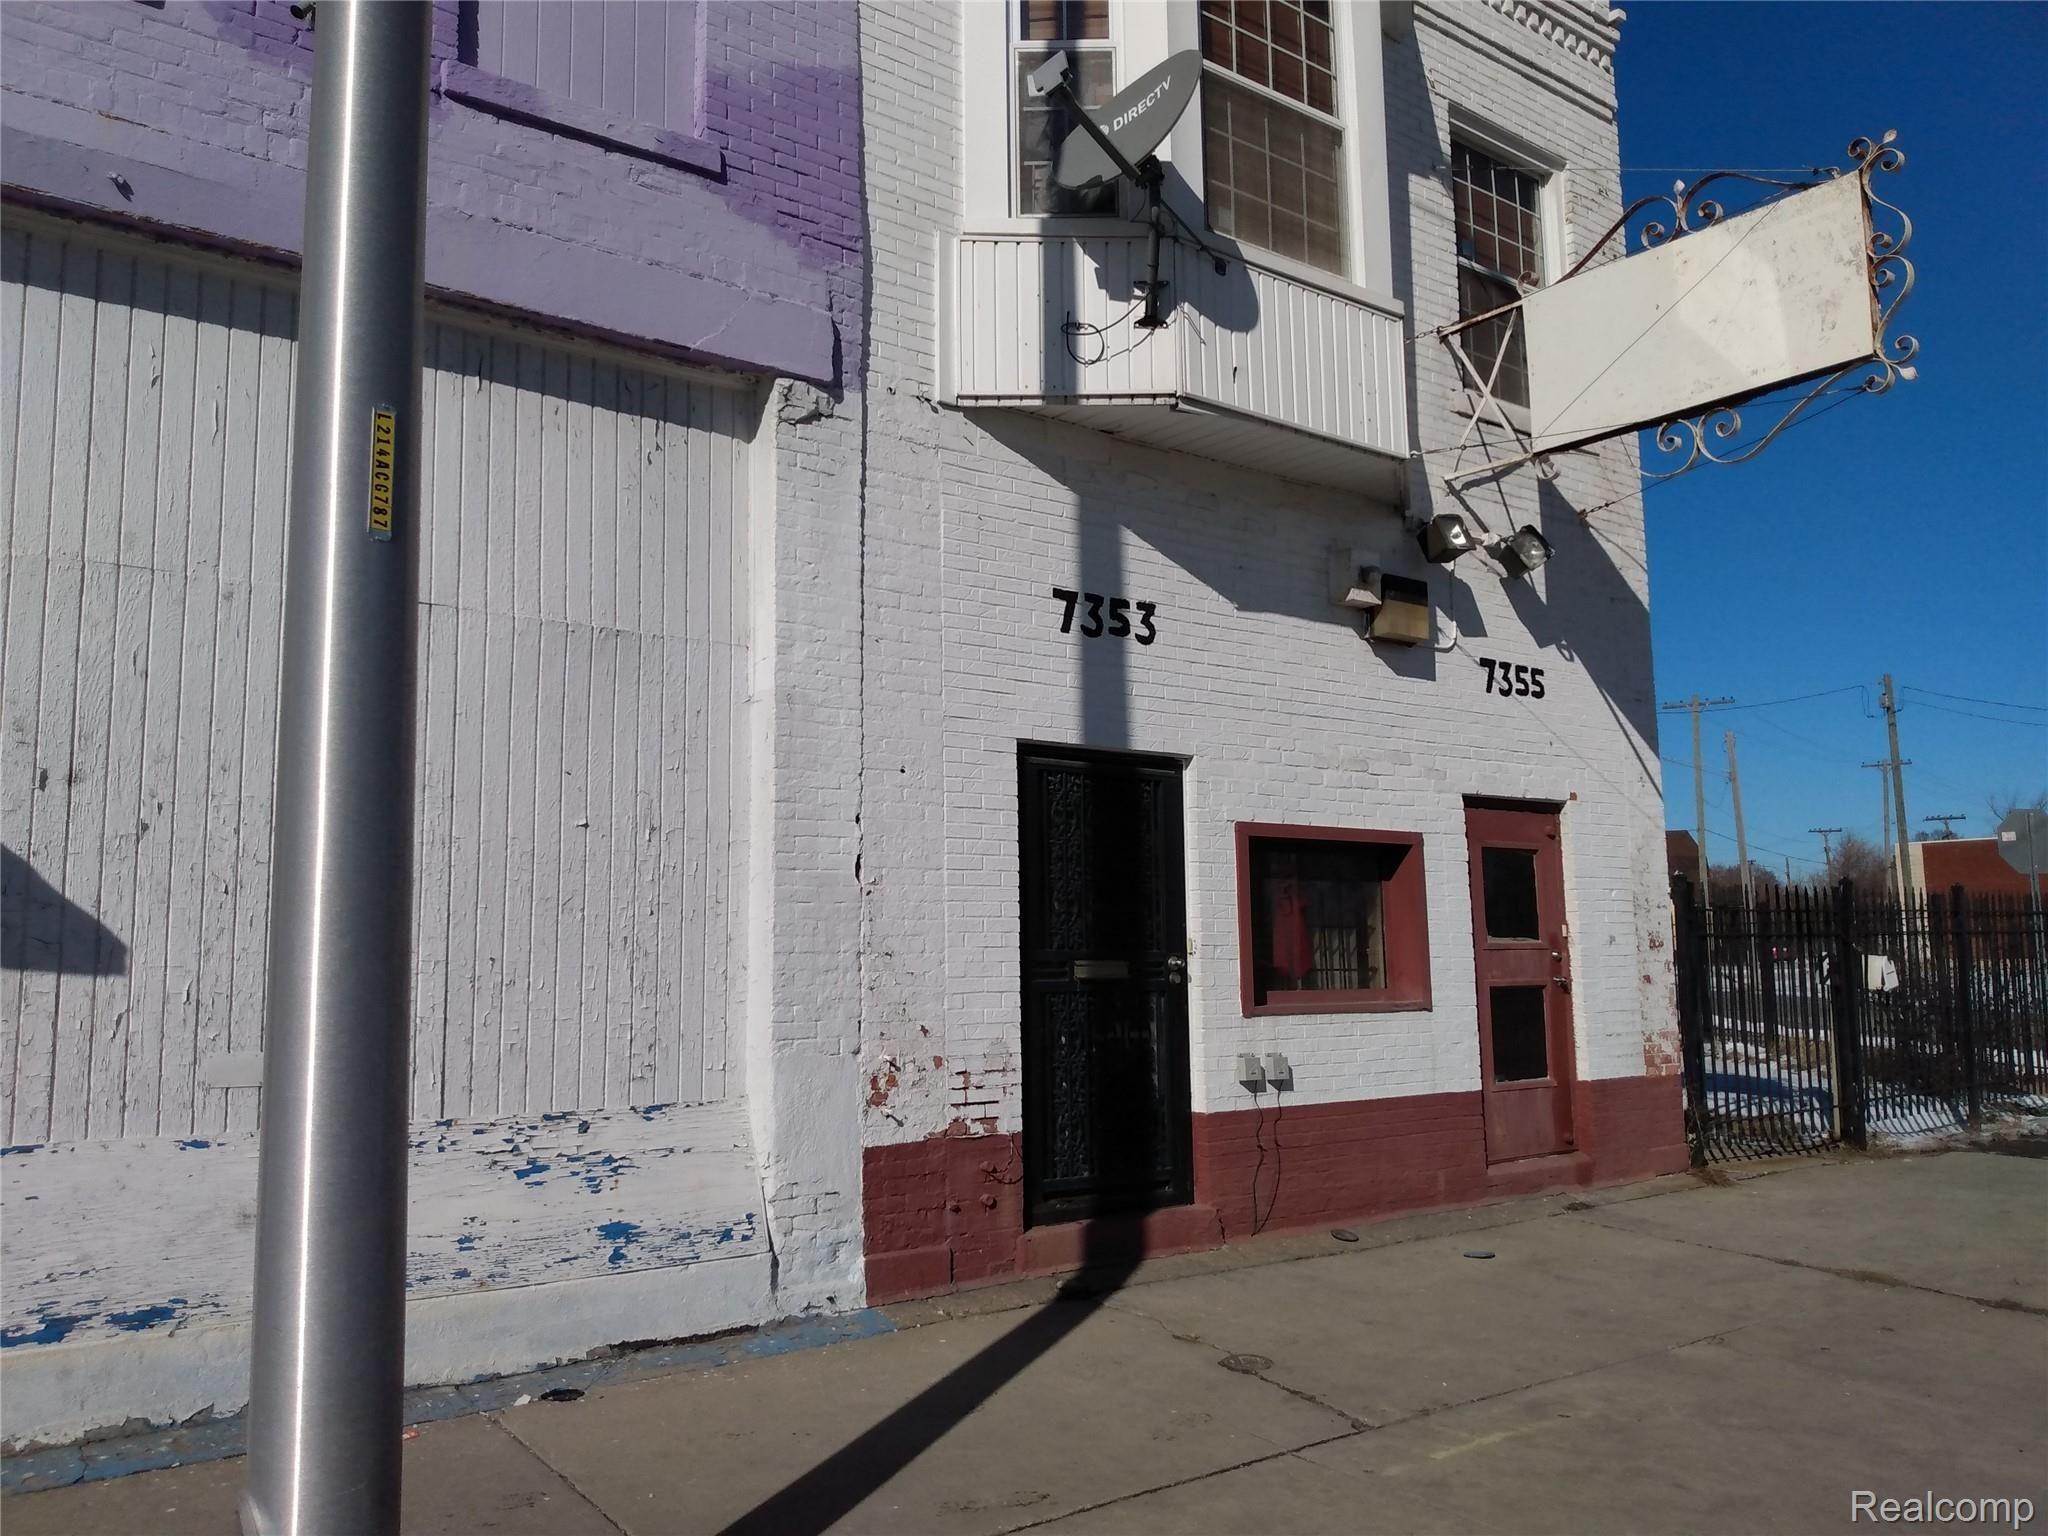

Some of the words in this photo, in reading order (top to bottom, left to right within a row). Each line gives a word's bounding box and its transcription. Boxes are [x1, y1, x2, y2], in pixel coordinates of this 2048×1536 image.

[1112, 75, 1172, 132] DIRECTV
[1052, 587, 1156, 645] 7353
[1479, 657, 1545, 699] 7355
